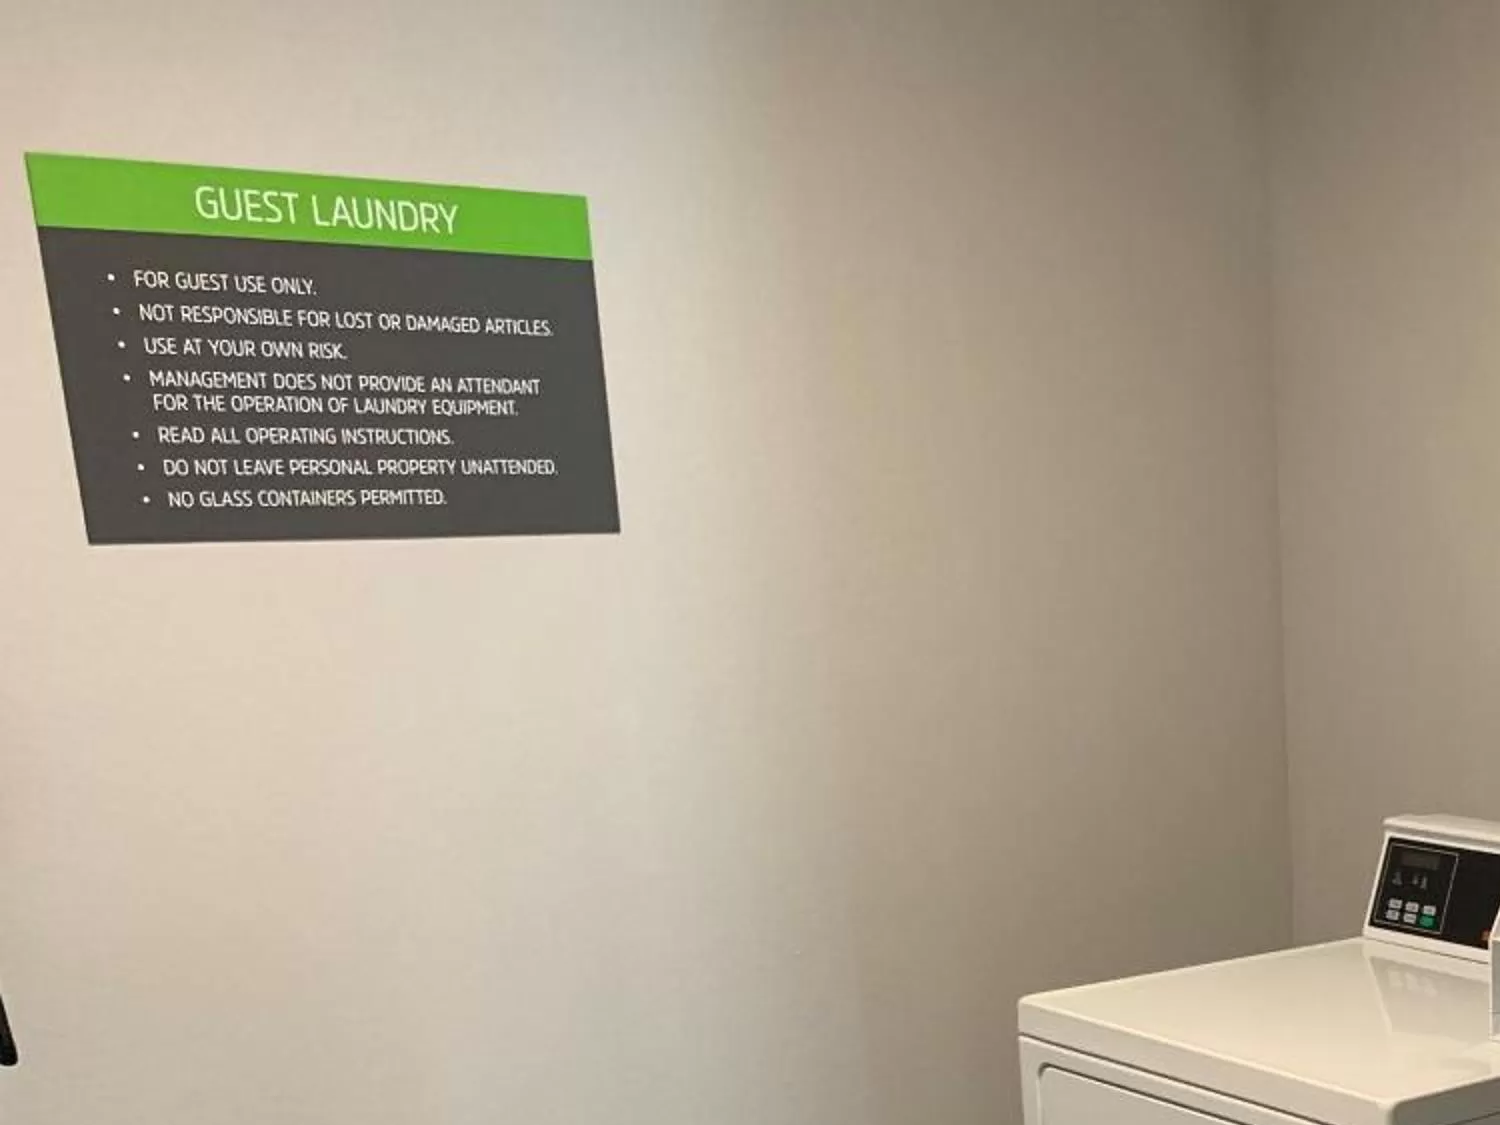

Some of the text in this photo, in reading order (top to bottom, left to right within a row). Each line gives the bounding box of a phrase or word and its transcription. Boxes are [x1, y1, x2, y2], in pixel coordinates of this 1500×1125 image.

[195, 185, 458, 234] GUEST LAUNDRY
[133, 269, 317, 296] FOR GUEST USE ONLY.
[138, 303, 553, 337] NOT RESPONSIBLE FOR LOST OR DAMAGED ARTICLES.
[143, 337, 348, 360] USE AT YOUR OWN RISK.
[148, 369, 541, 395] MANAGEMENT DOES NOT PROVIDE AN ATTENDANT
[153, 393, 518, 417] FOR THE OPERATION OF LAUNDRY EQUIPMENT.
[157, 425, 455, 445] READ ALL OPERATING INSTRUCTIONS.
[163, 458, 558, 476] DO NOT LEAVE PERSONAL PROPERTY UNATTENDED.
[167, 488, 447, 509] NO GLASS CONTAINERS PERMITTED.
